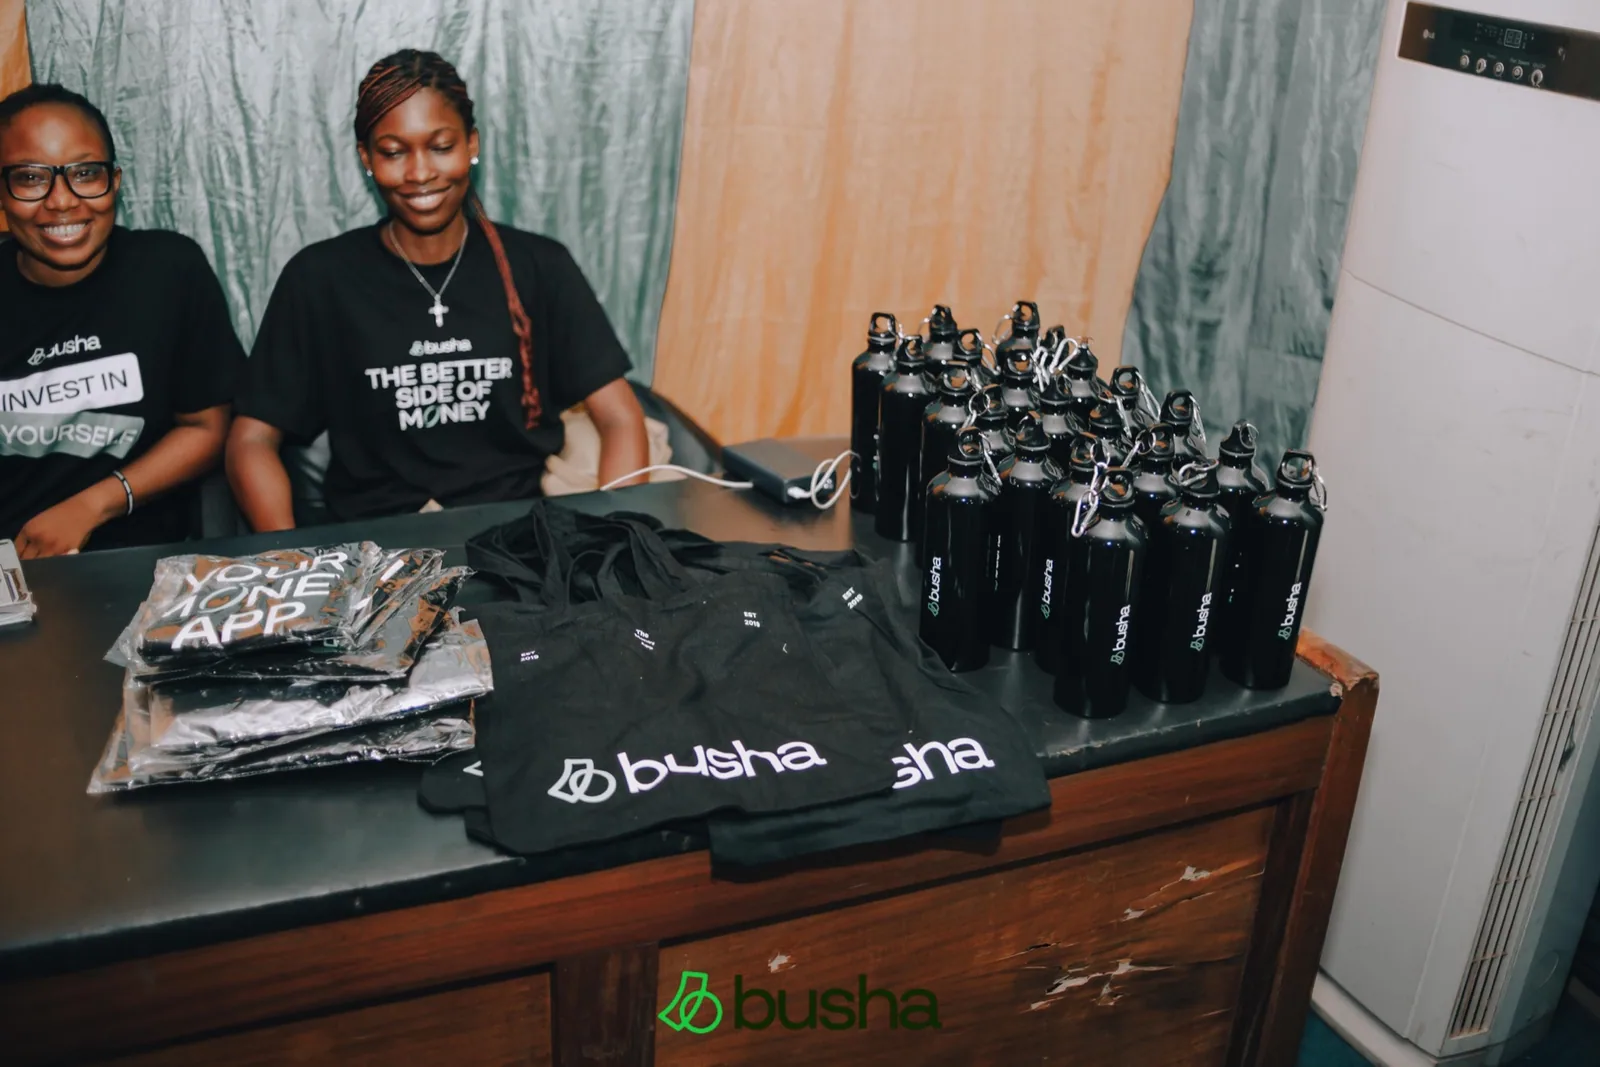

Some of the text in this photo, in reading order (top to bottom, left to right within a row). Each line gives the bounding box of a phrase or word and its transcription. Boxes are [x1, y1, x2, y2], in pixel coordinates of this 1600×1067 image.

[46, 334, 102, 358] usha
[424, 338, 473, 355] busha
[1, 369, 128, 412] INVEST IN
[365, 357, 513, 390] THE BETTER
[395, 380, 493, 409] SIDE OF
[398, 400, 491, 431] MONEY
[184, 551, 348, 593] YOUR
[928, 556, 942, 603] busha
[1042, 558, 1054, 605] busha
[171, 601, 306, 650] APP
[1192, 592, 1213, 638] busha
[1279, 582, 1302, 627] busha
[1112, 604, 1131, 653] busha
[617, 740, 827, 794] busha
[892, 736, 995, 789] sha
